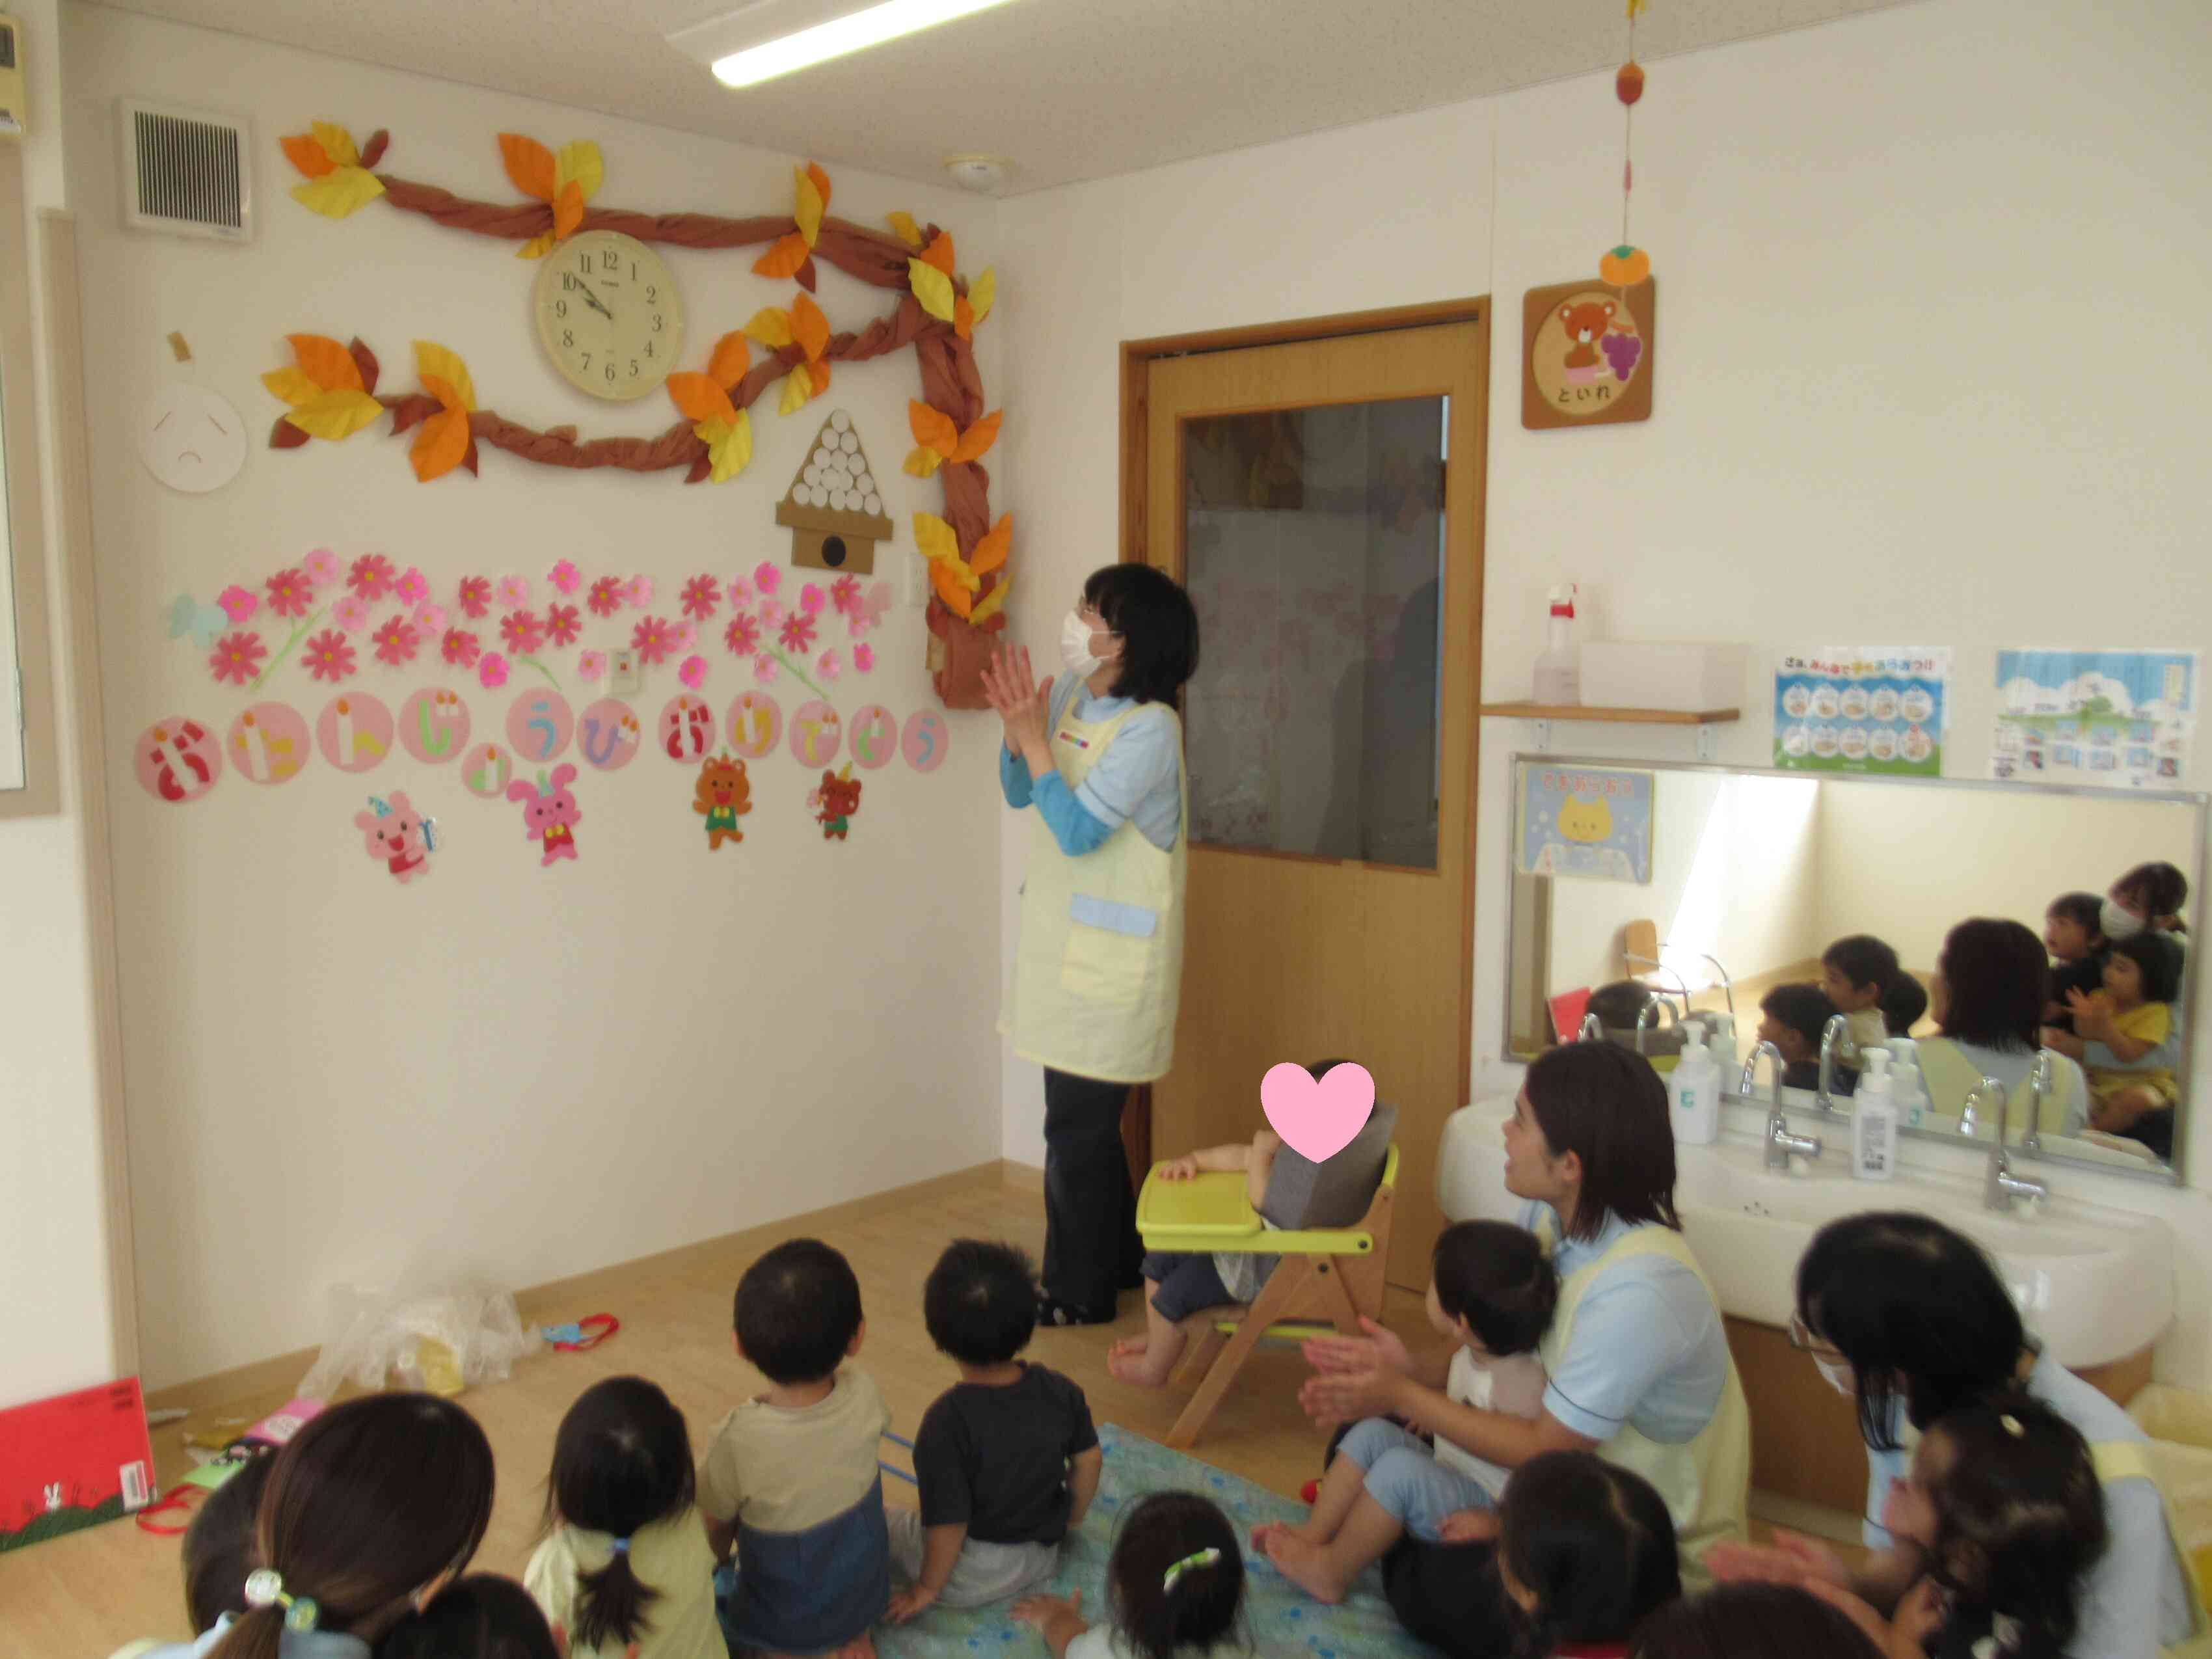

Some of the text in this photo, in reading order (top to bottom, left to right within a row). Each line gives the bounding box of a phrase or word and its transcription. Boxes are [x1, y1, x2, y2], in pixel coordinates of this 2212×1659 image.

[580, 254, 592, 274] 11
[603, 250, 617, 270] 12
[630, 262, 637, 281] 1
[563, 271, 577, 291] 10
[646, 286, 656, 304] 2
[556, 300, 567, 318] 9
[652, 314, 662, 332] 3
[563, 329, 573, 347] 8
[643, 340, 653, 357] 4
[582, 353, 591, 370] 7
[630, 359, 638, 377] 5
[605, 364, 615, 381] 6
[1558, 386, 1610, 402] といれ
